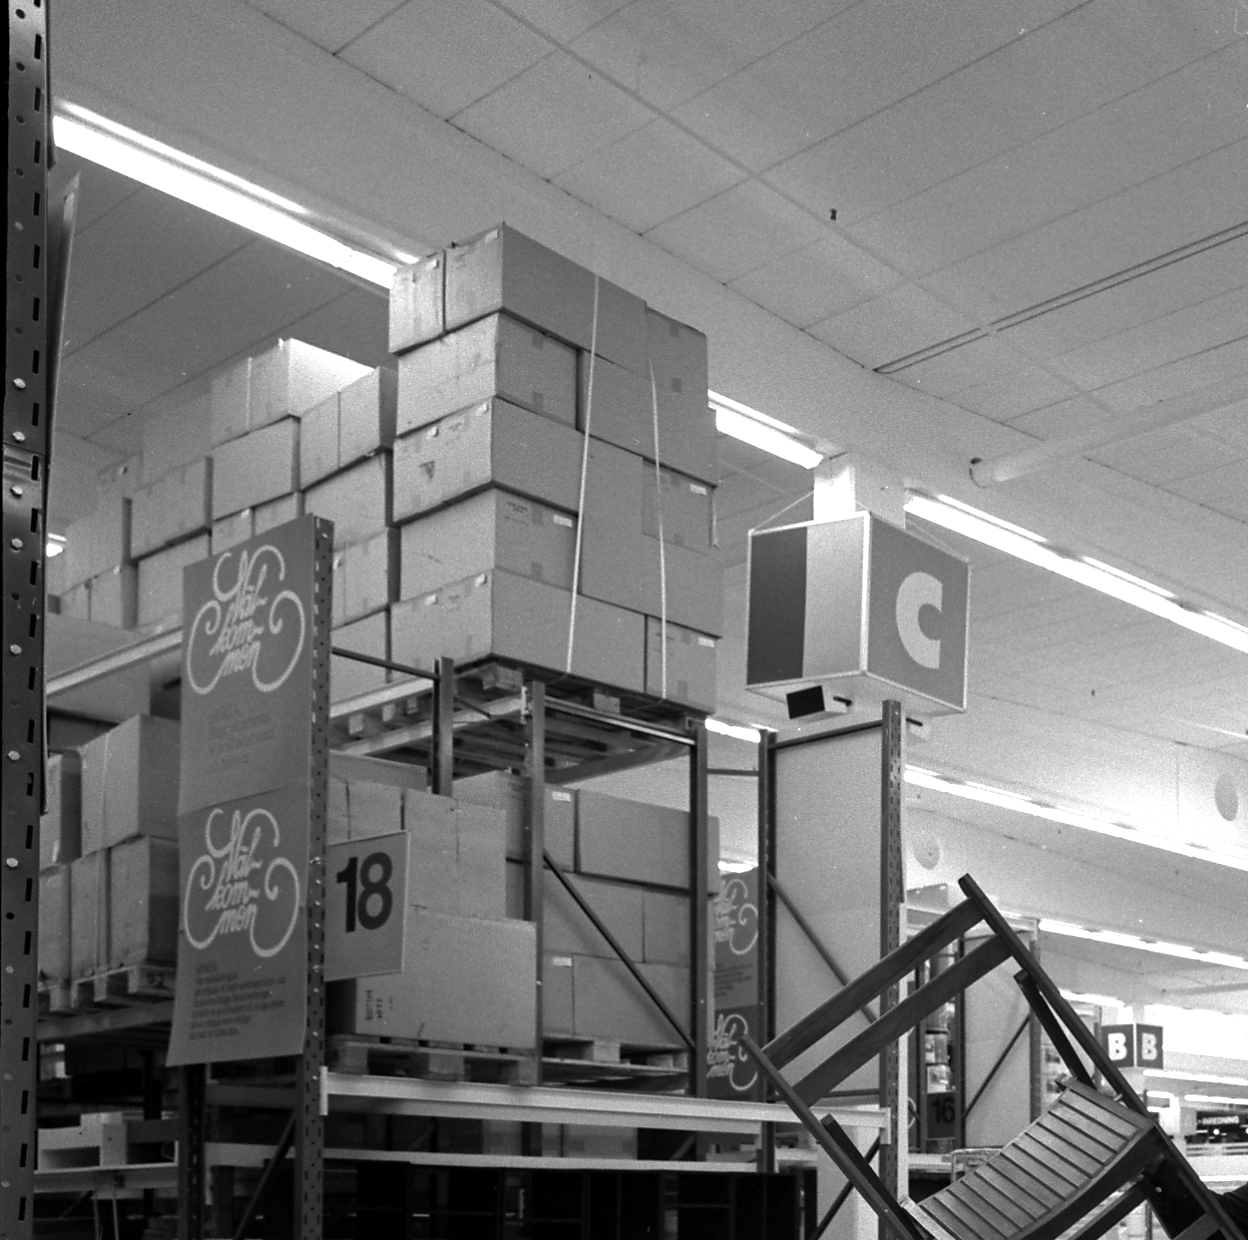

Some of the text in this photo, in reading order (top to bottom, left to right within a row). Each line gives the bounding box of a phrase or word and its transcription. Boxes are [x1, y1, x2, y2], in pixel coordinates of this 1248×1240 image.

[895, 571, 943, 670] C
[335, 851, 393, 933] 18
[1107, 1032, 1127, 1060] B
[1141, 1032, 1158, 1060] B
[931, 1096, 956, 1124] 16
